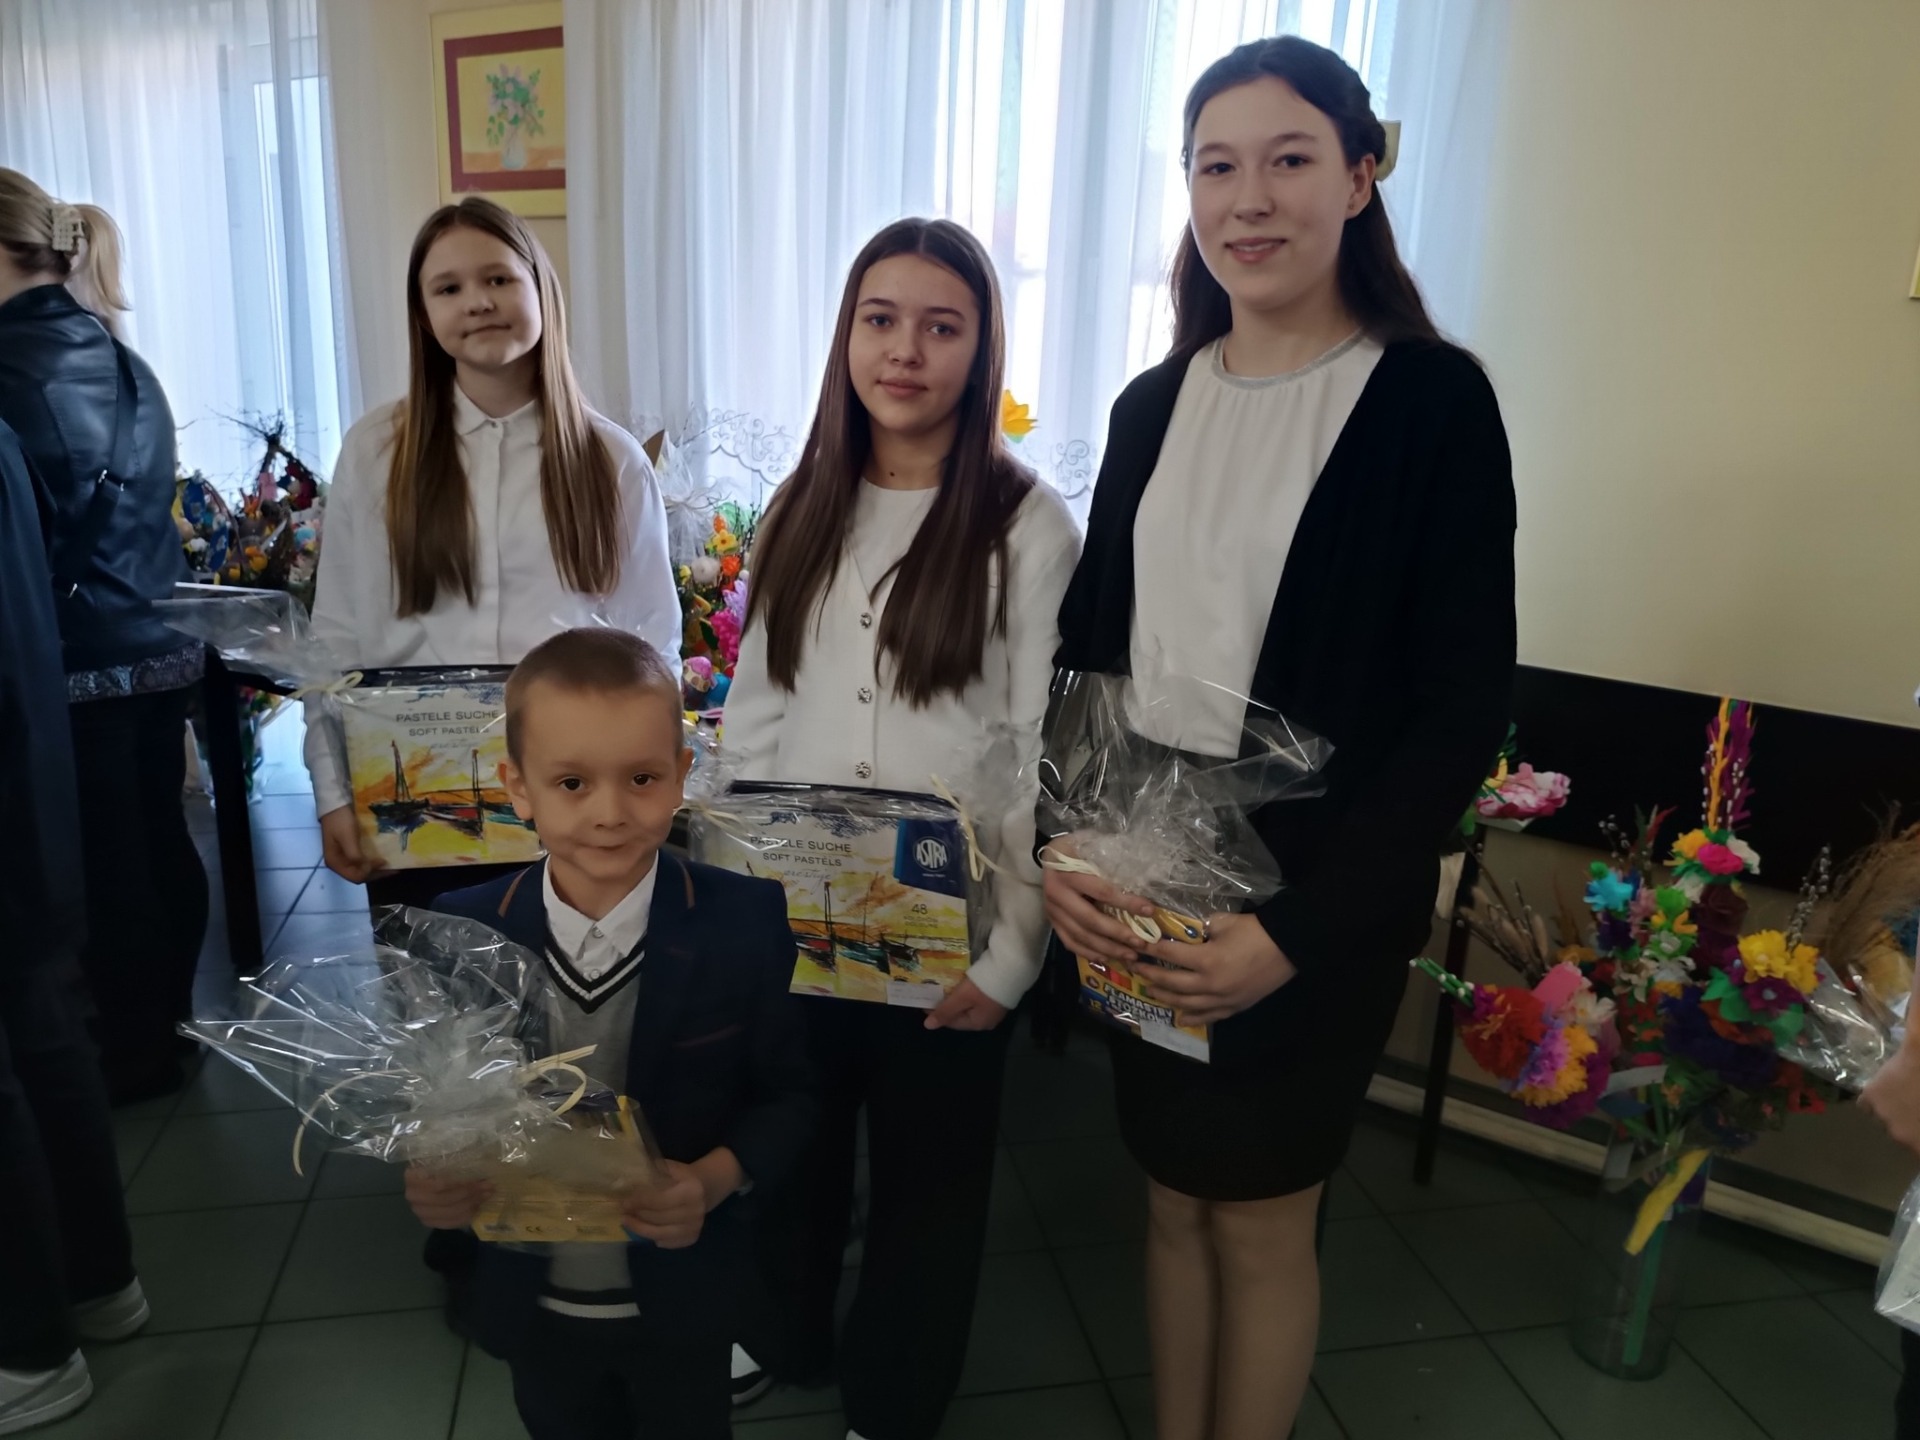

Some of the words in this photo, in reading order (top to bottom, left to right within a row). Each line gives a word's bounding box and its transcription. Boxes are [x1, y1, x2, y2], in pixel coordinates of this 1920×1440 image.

[396, 711, 451, 722] PASTELE
[455, 709, 500, 720] SUCHE
[408, 727, 438, 737] SOFT
[750, 836, 805, 849] PASTELE
[807, 840, 853, 853] SUCHE
[762, 852, 791, 861] SOFT
[794, 855, 842, 867] PASTELS
[916, 838, 948, 869] ASTRA
[911, 903, 929, 915] 48
[1103, 983, 1173, 1018] FLAMASTRY
